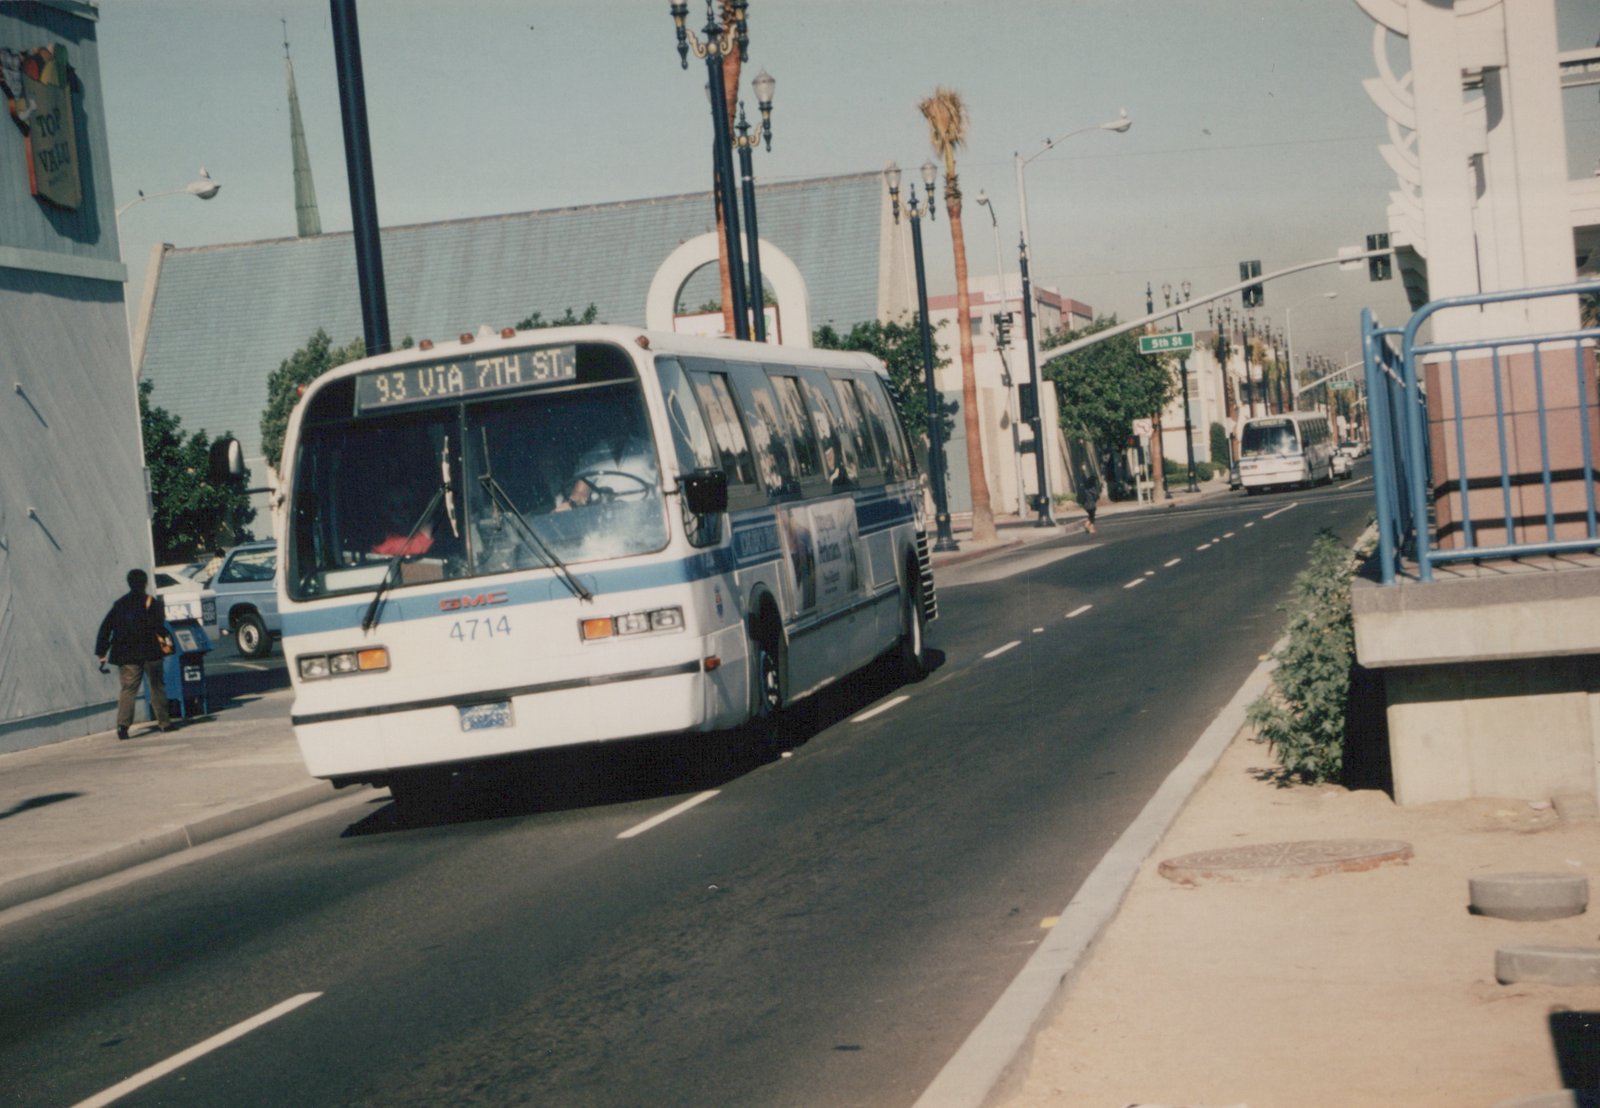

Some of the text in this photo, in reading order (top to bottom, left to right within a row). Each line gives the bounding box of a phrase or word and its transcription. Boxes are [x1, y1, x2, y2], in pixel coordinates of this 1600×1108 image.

[1172, 335, 1183, 346] St
[376, 372, 407, 402] 93
[418, 363, 464, 396] VIA
[475, 354, 521, 388] 7TH
[438, 591, 509, 611] GMC
[449, 615, 512, 642] 4714
